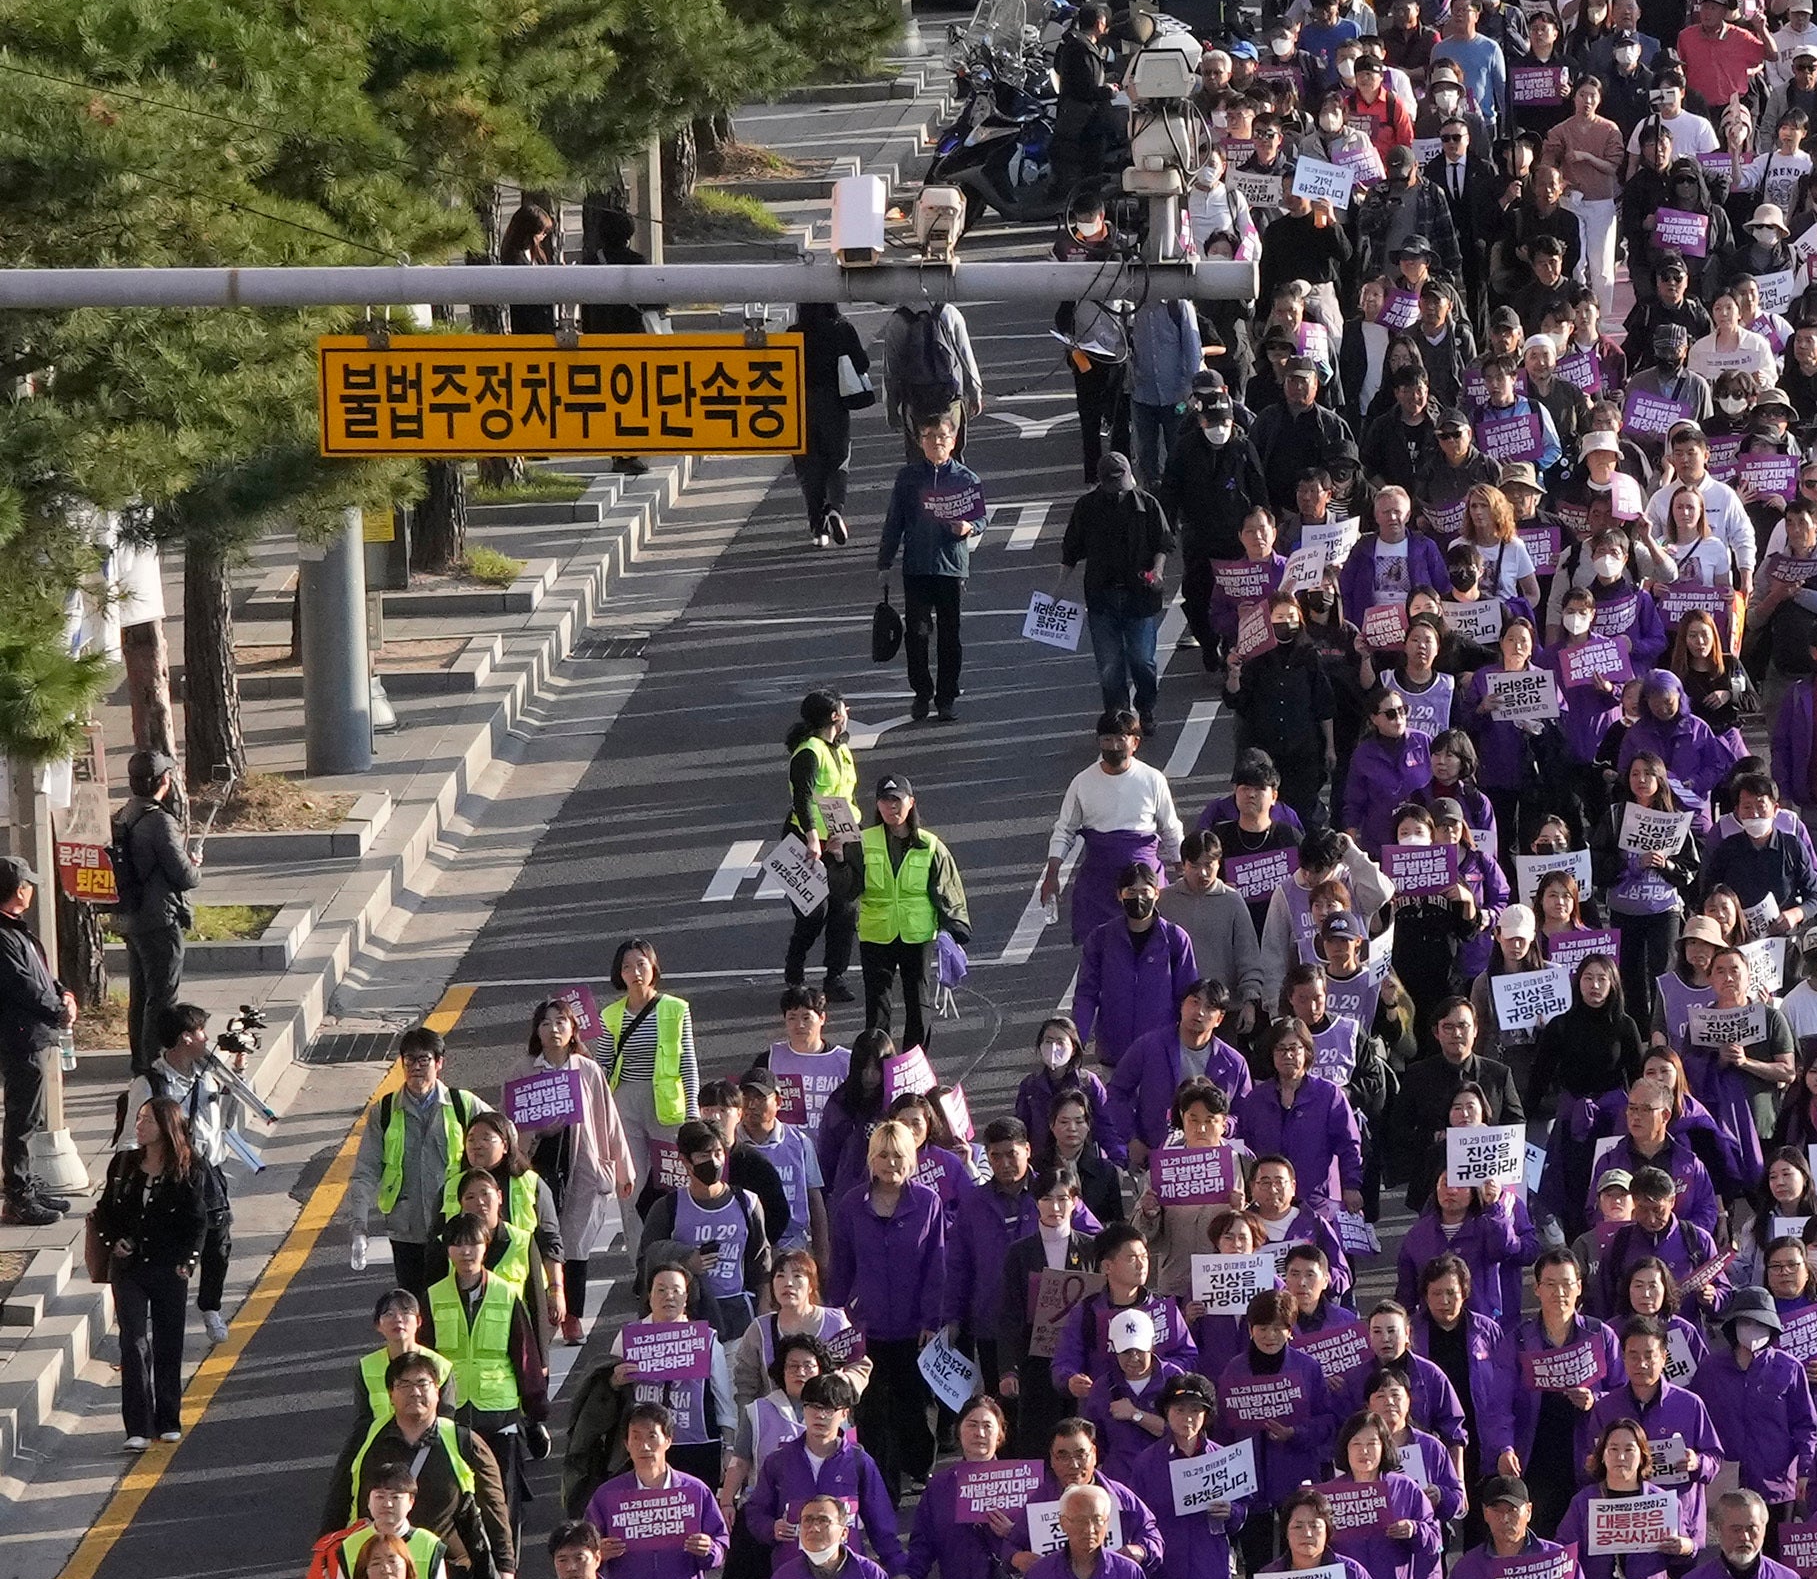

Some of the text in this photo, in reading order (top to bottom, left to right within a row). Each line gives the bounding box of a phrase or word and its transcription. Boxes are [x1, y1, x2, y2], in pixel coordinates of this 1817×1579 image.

[339, 361, 788, 441] 불법주정차무인단속중
[1466, 1142, 1511, 1163] 진상을
[1456, 1157, 1518, 1183] 규명하라!
[626, 1337, 706, 1361] 재발방지대책
[638, 1355, 696, 1373] 마련하라!
[959, 1476, 1040, 1499] 재발방지대책
[1202, 1467, 1229, 1487] 기억
[1182, 1471, 1249, 1509] 하겠습니다
[970, 1494, 1029, 1513] 마련하라!
[1633, 1498, 1668, 1511] 인정하고
[1596, 1509, 1665, 1529] 대통령은
